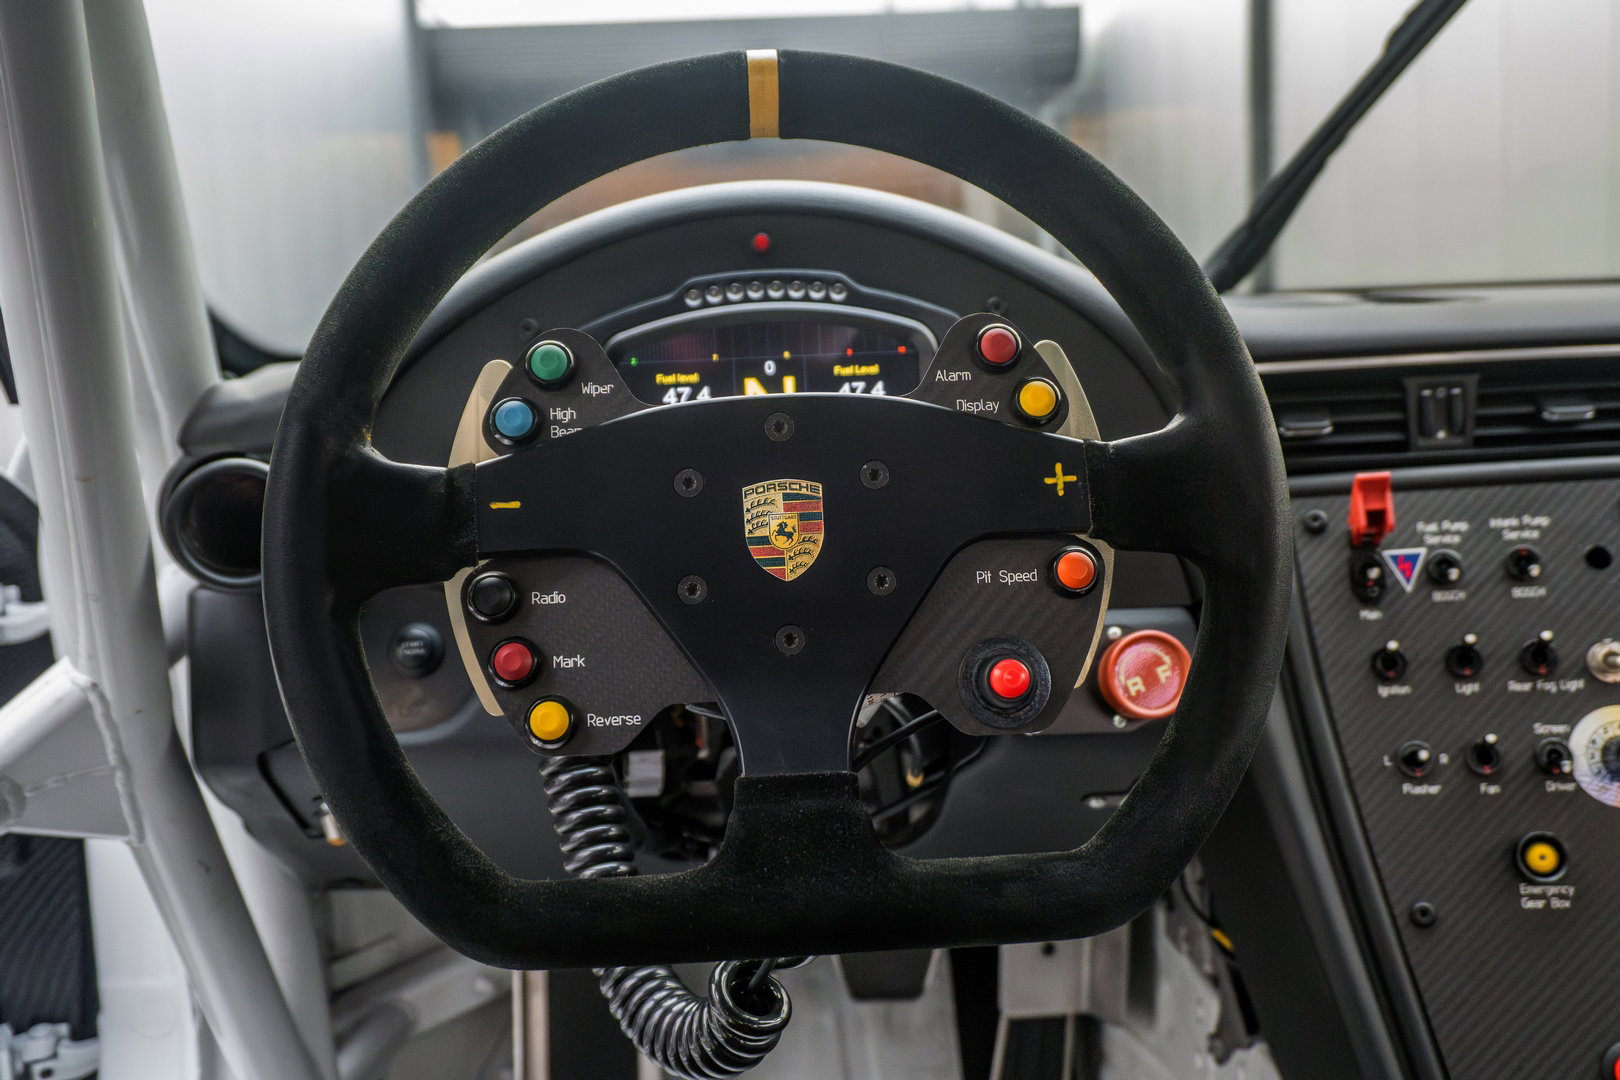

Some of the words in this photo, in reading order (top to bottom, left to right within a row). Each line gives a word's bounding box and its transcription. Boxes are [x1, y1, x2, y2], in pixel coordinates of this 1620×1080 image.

[763, 360, 777, 376] 0
[833, 364, 853, 377] Fuel
[855, 363, 880, 376] Level
[655, 373, 676, 385] Fuel
[935, 370, 972, 382] Alarm
[581, 382, 614, 397] Wiper
[662, 385, 712, 404] 474
[838, 380, 887, 395] 474
[956, 399, 1000, 414] Display
[550, 407, 577, 423] High
[743, 482, 821, 499] PORSCHE
[1416, 521, 1439, 532] Fuel
[1440, 520, 1469, 532] Pump
[1521, 514, 1551, 527] Pump
[1423, 534, 1462, 545] Service
[1501, 529, 1541, 541] Service
[976, 571, 992, 584] Pit
[999, 569, 1038, 585] Speed
[531, 591, 566, 605] Radio
[553, 655, 585, 668] Mark
[1126, 677, 1146, 697] R
[1455, 682, 1480, 695] Light
[1507, 681, 1533, 692] Rear
[1536, 680, 1557, 692] Fog
[1559, 678, 1584, 691] Light
[587, 713, 642, 727] Reverse
[1383, 755, 1393, 767] L
[1479, 782, 1501, 794] Fan
[1545, 780, 1577, 792] Driver
[1519, 883, 1575, 897] Emergency
[1521, 897, 1547, 909] Gear
[1551, 896, 1572, 909] Box
